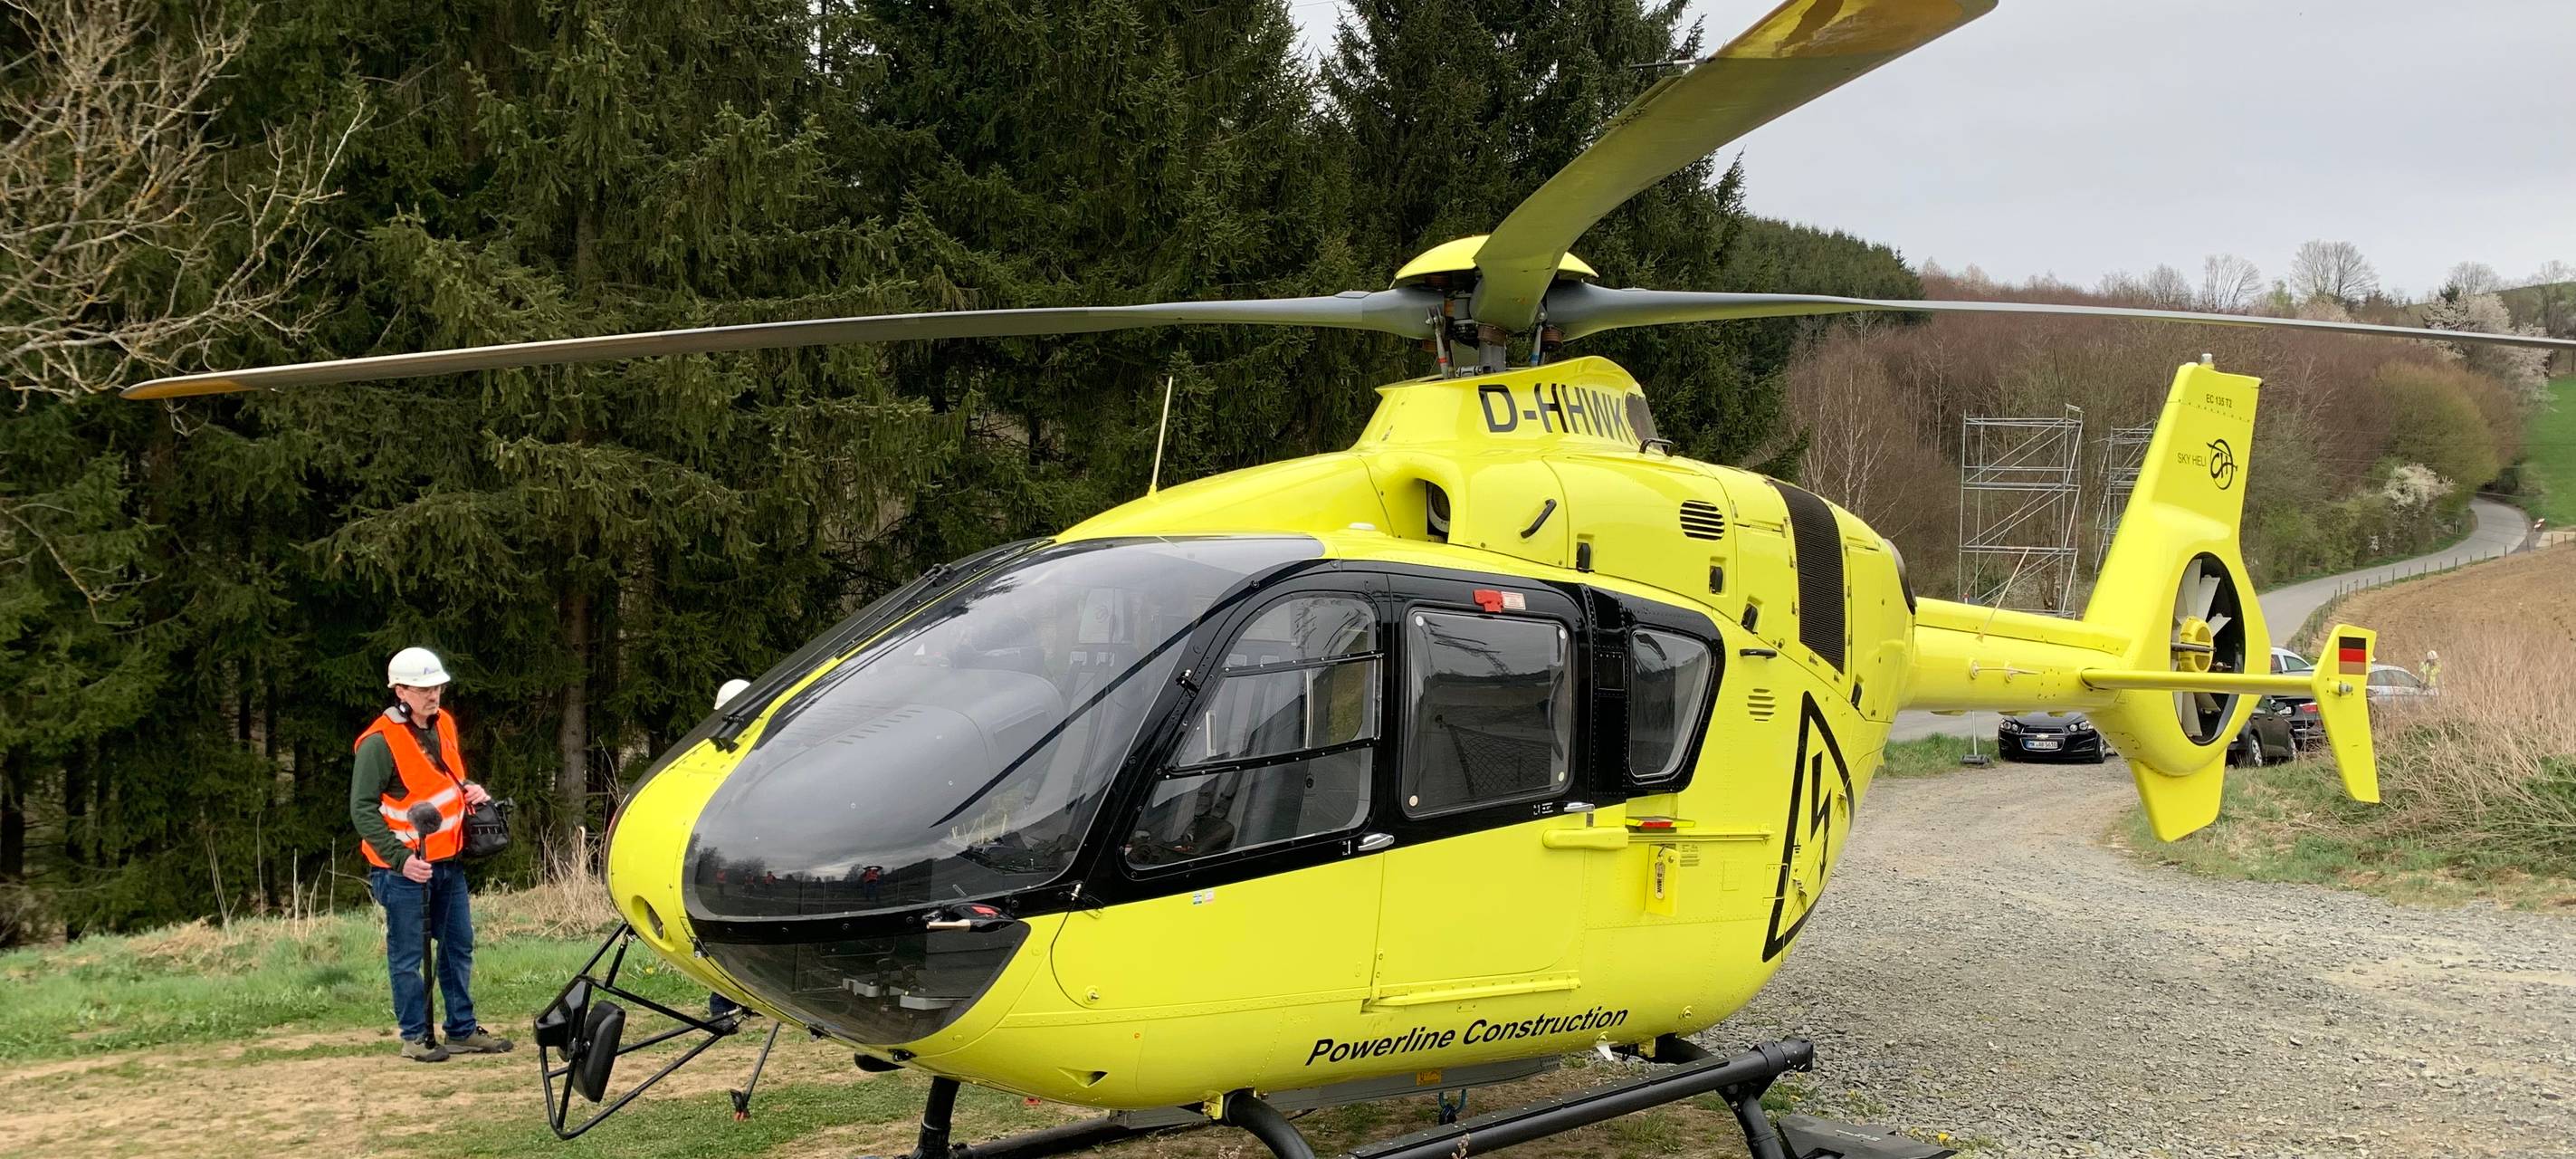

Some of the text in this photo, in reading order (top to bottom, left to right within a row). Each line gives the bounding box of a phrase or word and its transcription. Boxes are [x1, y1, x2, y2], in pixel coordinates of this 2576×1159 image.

[1478, 382, 1633, 445] D-HHWK
[2206, 393, 2232, 408] EC 135 T2
[2177, 452, 2207, 467] SKY HELI
[1305, 1005, 1629, 1067] Powerline Construction
